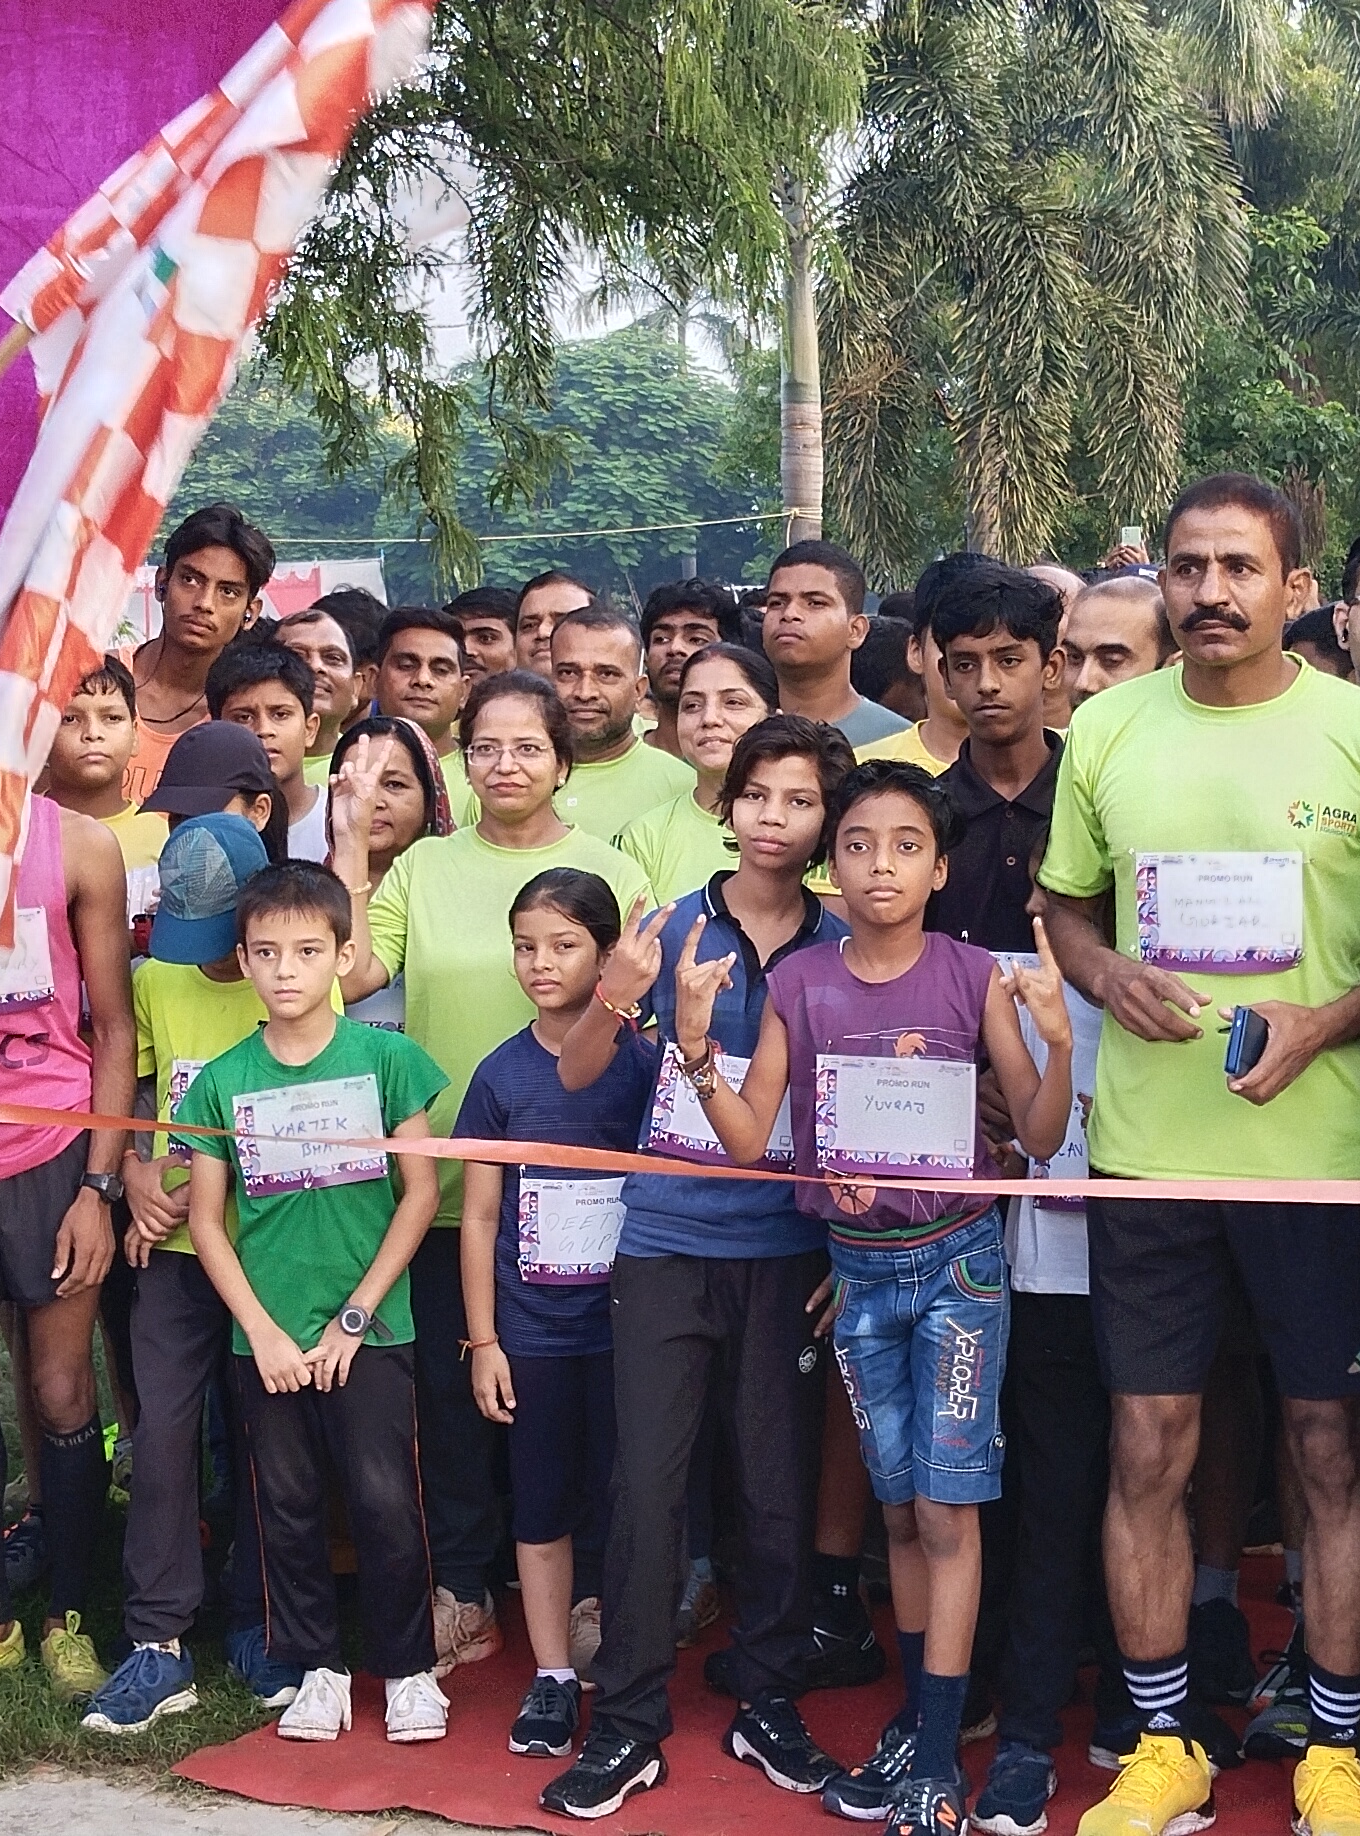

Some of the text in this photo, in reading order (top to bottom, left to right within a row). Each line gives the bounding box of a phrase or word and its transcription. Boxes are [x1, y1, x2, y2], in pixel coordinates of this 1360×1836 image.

[1322, 806, 1357, 824] AGRA
[1198, 874, 1254, 883] PROMO RUN
[876, 1078, 931, 1089] PROMO RUN
[290, 1100, 339, 1112] PROMO RUN
[864, 1094, 926, 1115] YUVRAJ
[575, 1197, 605, 1206] PROMO
[558, 1233, 620, 1255] GUP
[936, 1316, 984, 1421] XPLORER
